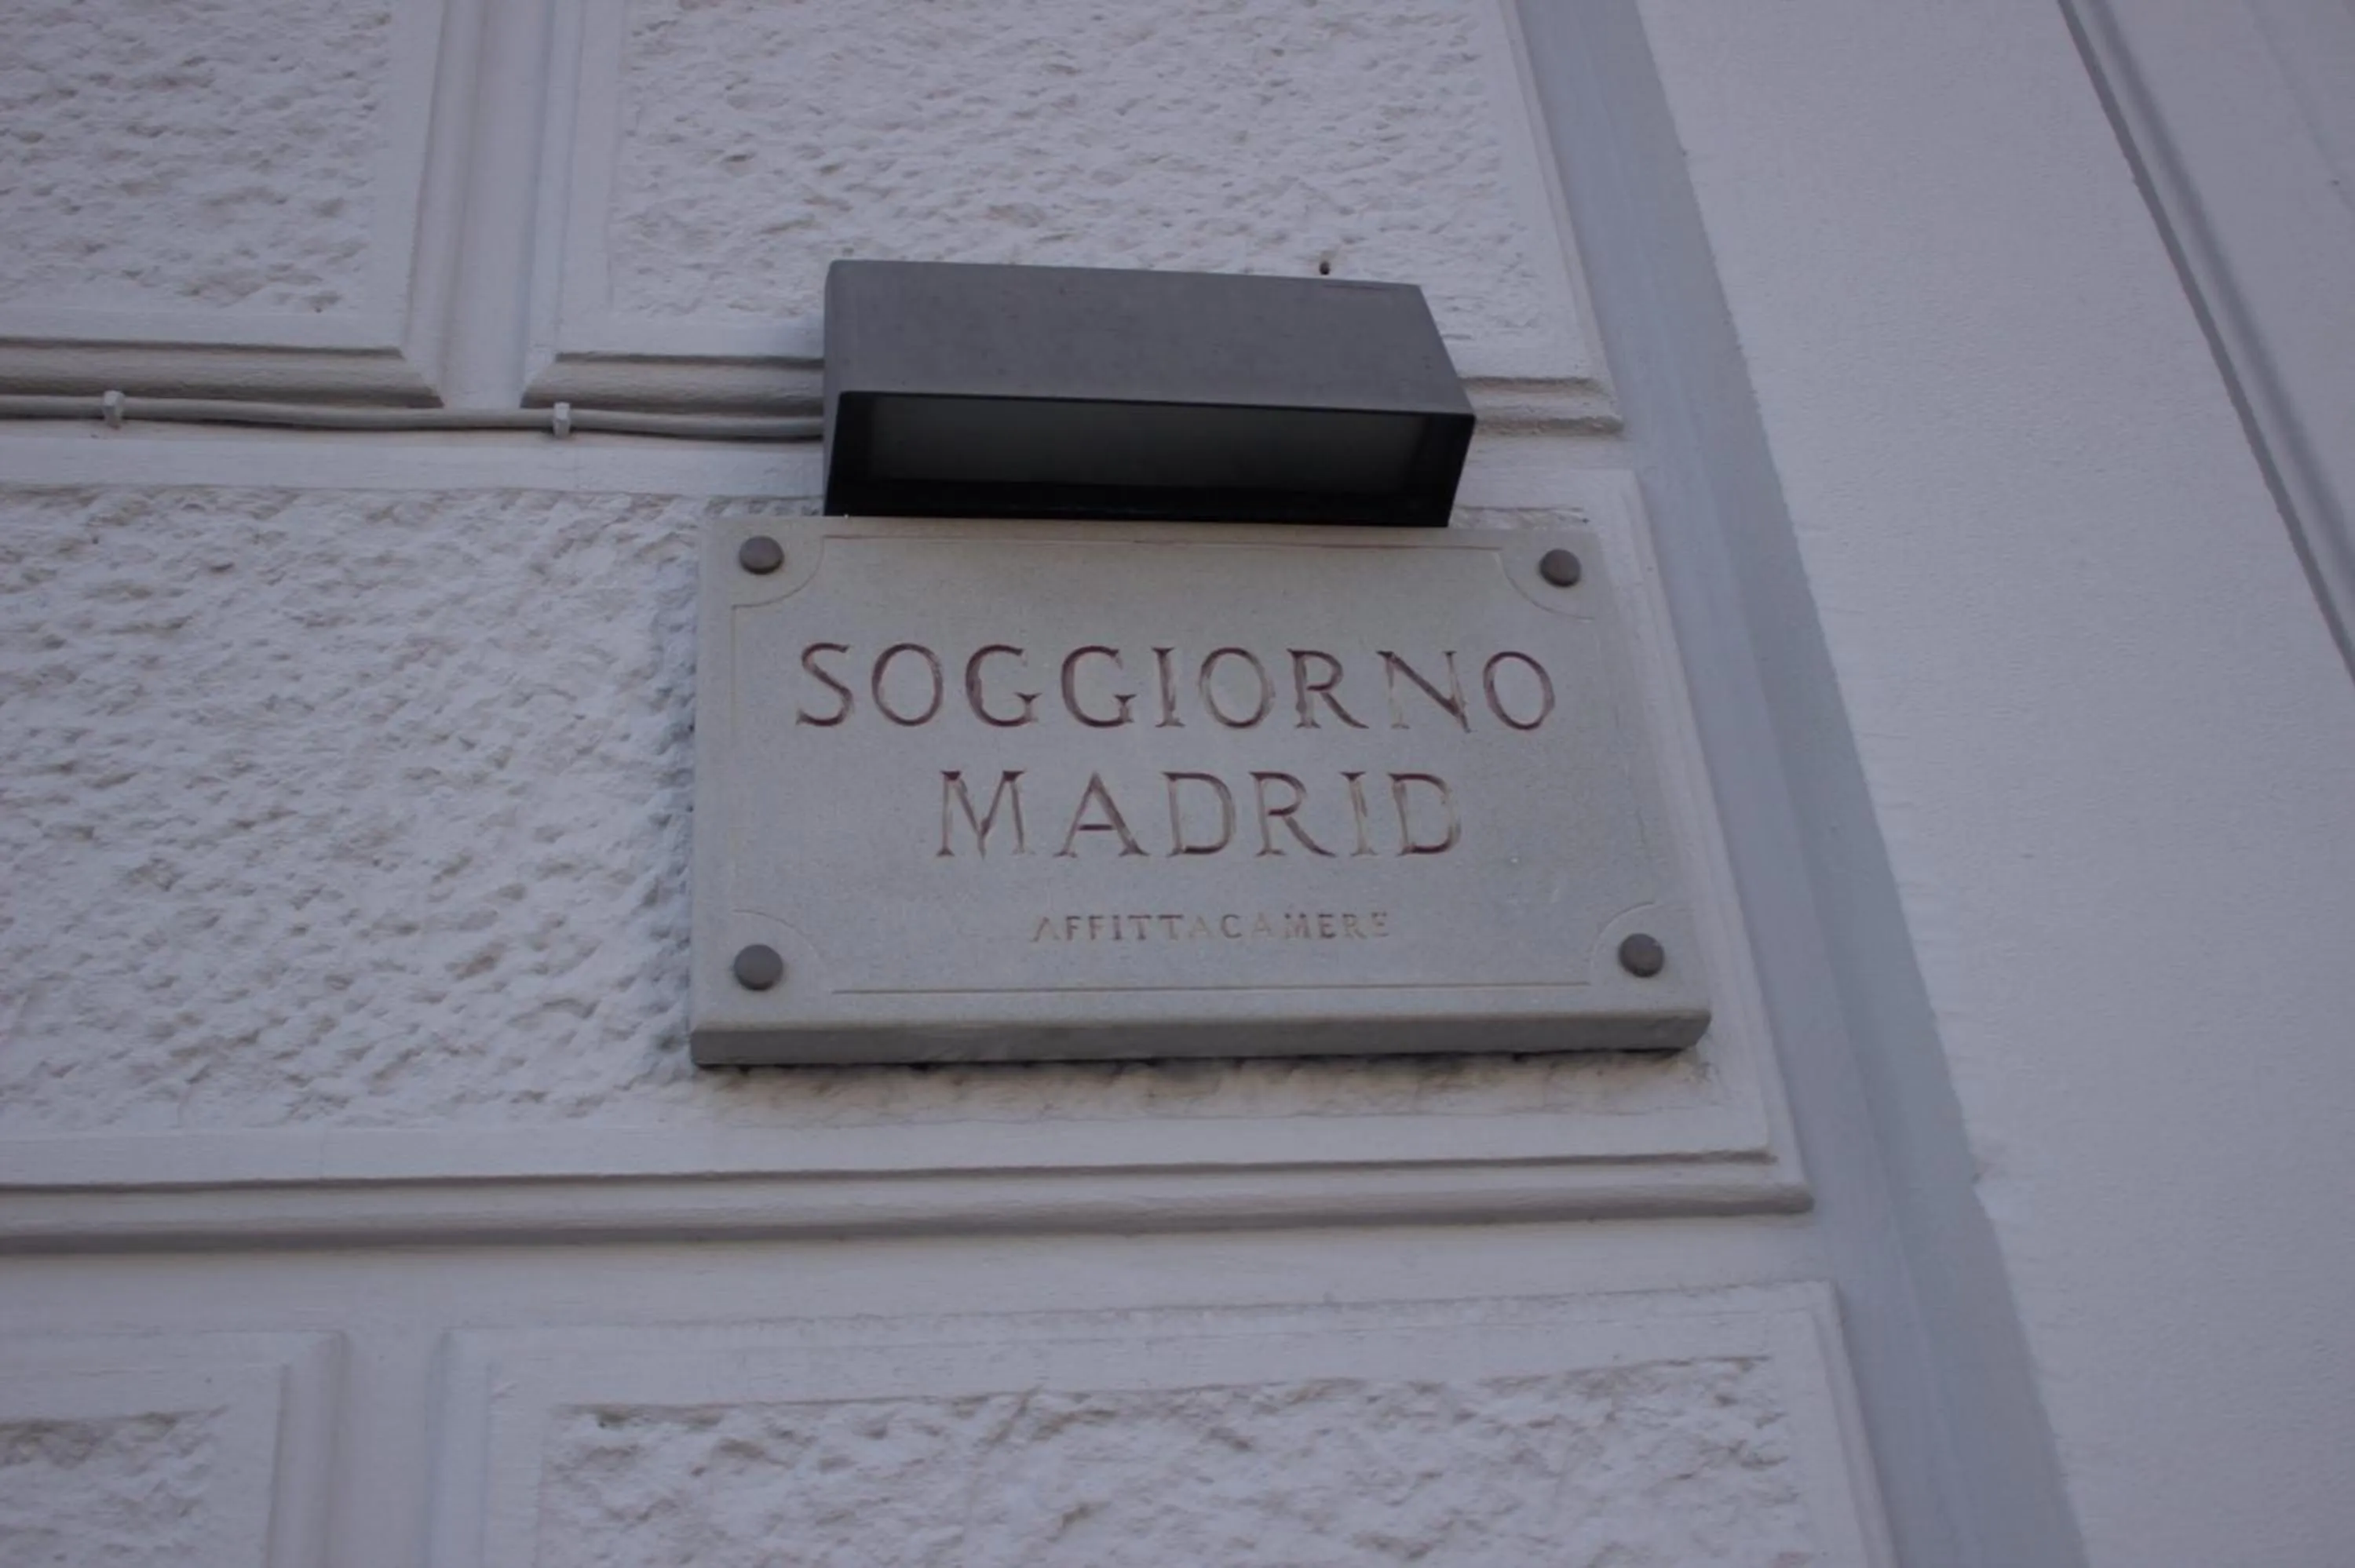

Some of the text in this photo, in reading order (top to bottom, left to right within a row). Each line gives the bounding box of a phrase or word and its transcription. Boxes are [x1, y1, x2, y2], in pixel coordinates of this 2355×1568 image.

[795, 642, 1556, 733] SOGGIORNO
[936, 770, 1462, 858] MADRID
[1032, 912, 1391, 942] AFFITTACAMERE
